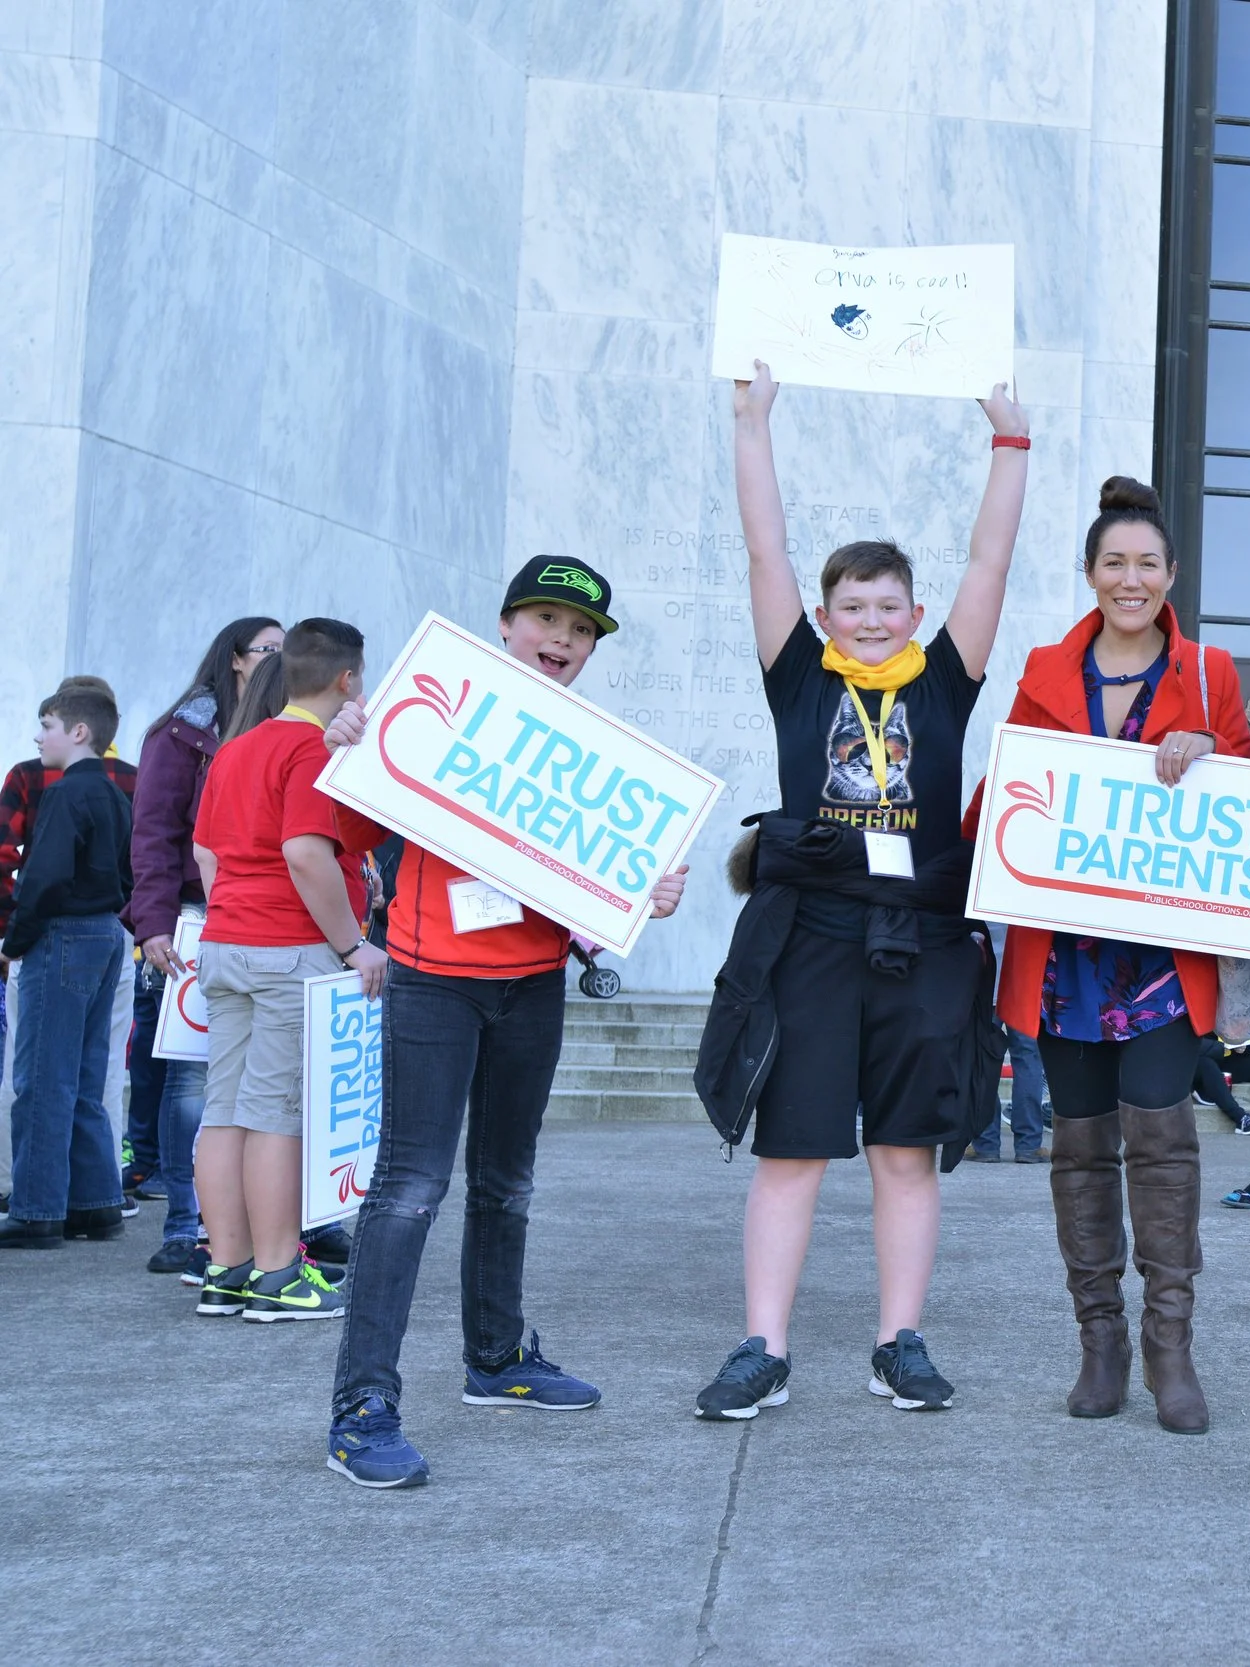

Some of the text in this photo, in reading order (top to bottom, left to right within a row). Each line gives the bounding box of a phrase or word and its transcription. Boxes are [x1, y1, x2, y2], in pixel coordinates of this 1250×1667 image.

[810, 505, 879, 524] STATE
[626, 528, 642, 545] IS
[653, 530, 746, 551] FORMED
[648, 566, 673, 582] BY
[683, 567, 726, 586] THE
[665, 600, 742, 621] OF THE
[607, 671, 682, 691] UNDER
[694, 675, 736, 693] THE
[621, 707, 665, 726] FOR
[676, 711, 719, 729] THE
[462, 693, 688, 846] I TRUST
[1064, 774, 1080, 824] I
[434, 742, 656, 892] PARENTS
[329, 988, 364, 1158] I TRUST
[361, 1000, 383, 1150] PARENT
